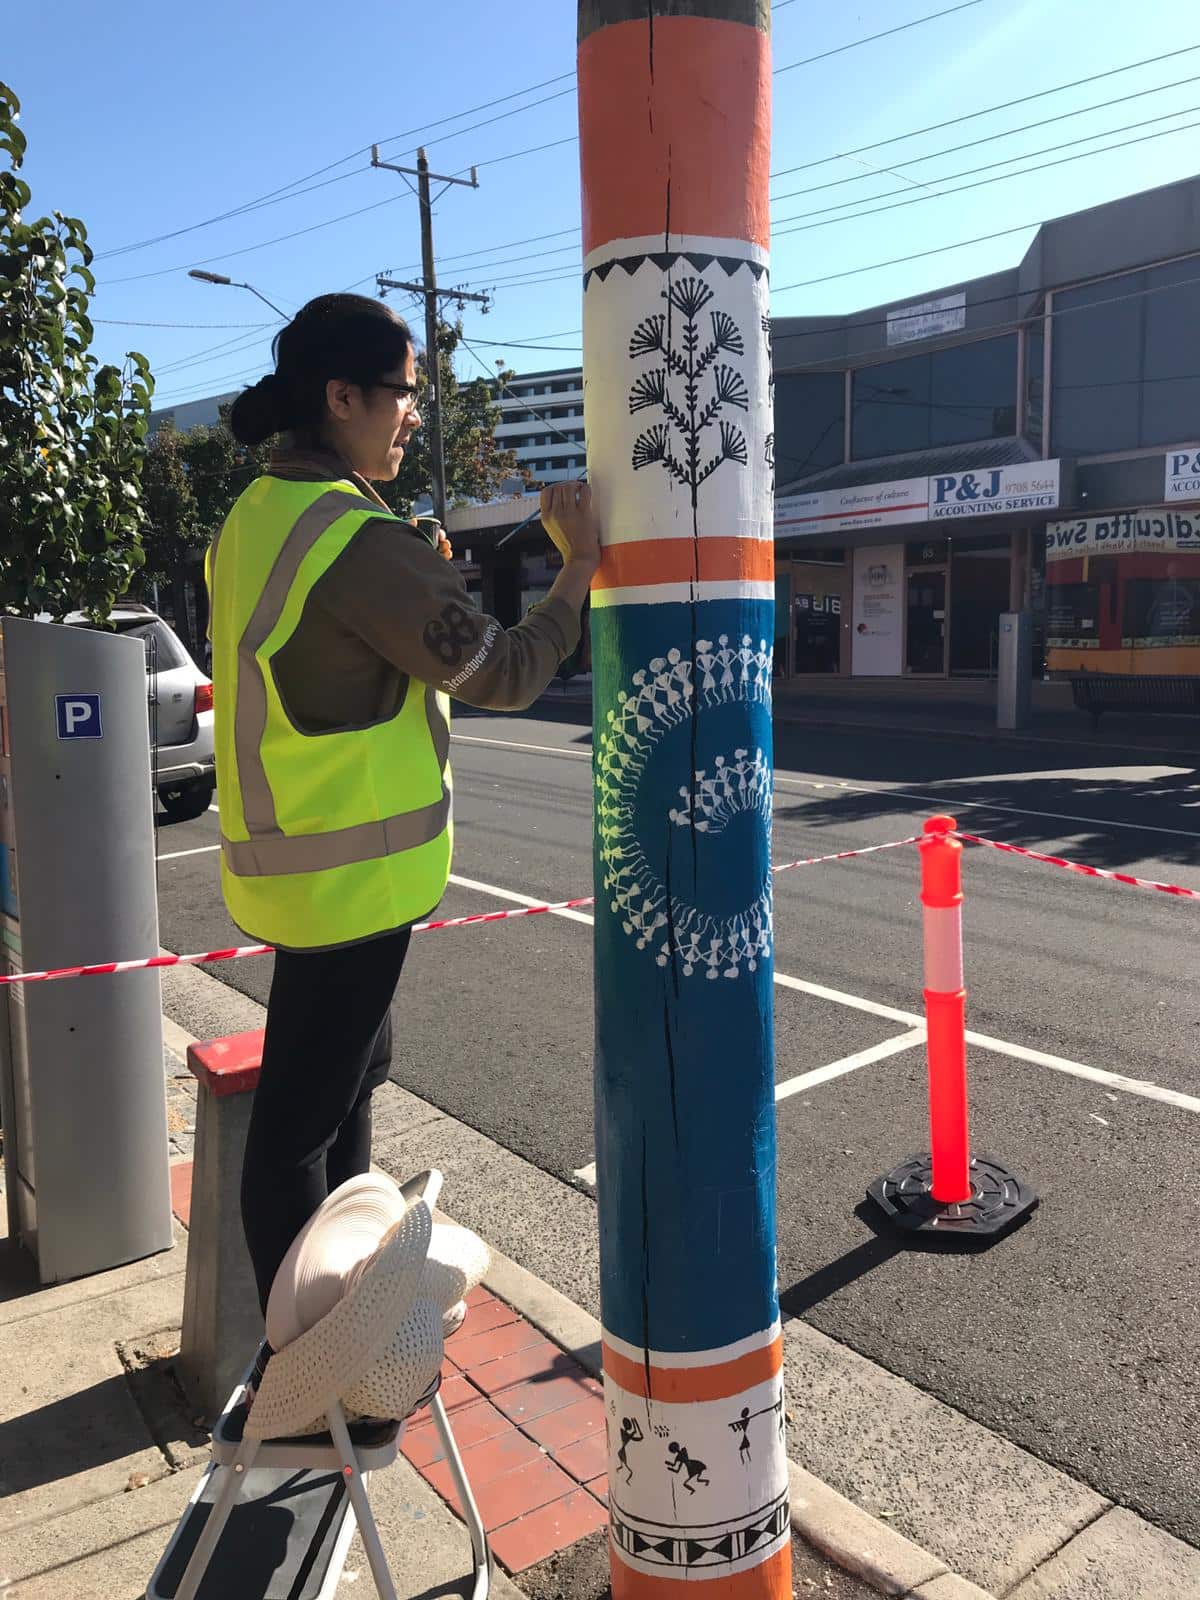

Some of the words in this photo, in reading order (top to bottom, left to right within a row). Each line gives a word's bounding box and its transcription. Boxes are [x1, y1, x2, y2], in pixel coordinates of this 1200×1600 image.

[933, 469, 1004, 504] P&J
[933, 502, 1002, 518] ACCOUNTING
[1005, 495, 1055, 510] SERVICE
[65, 701, 92, 733] P
